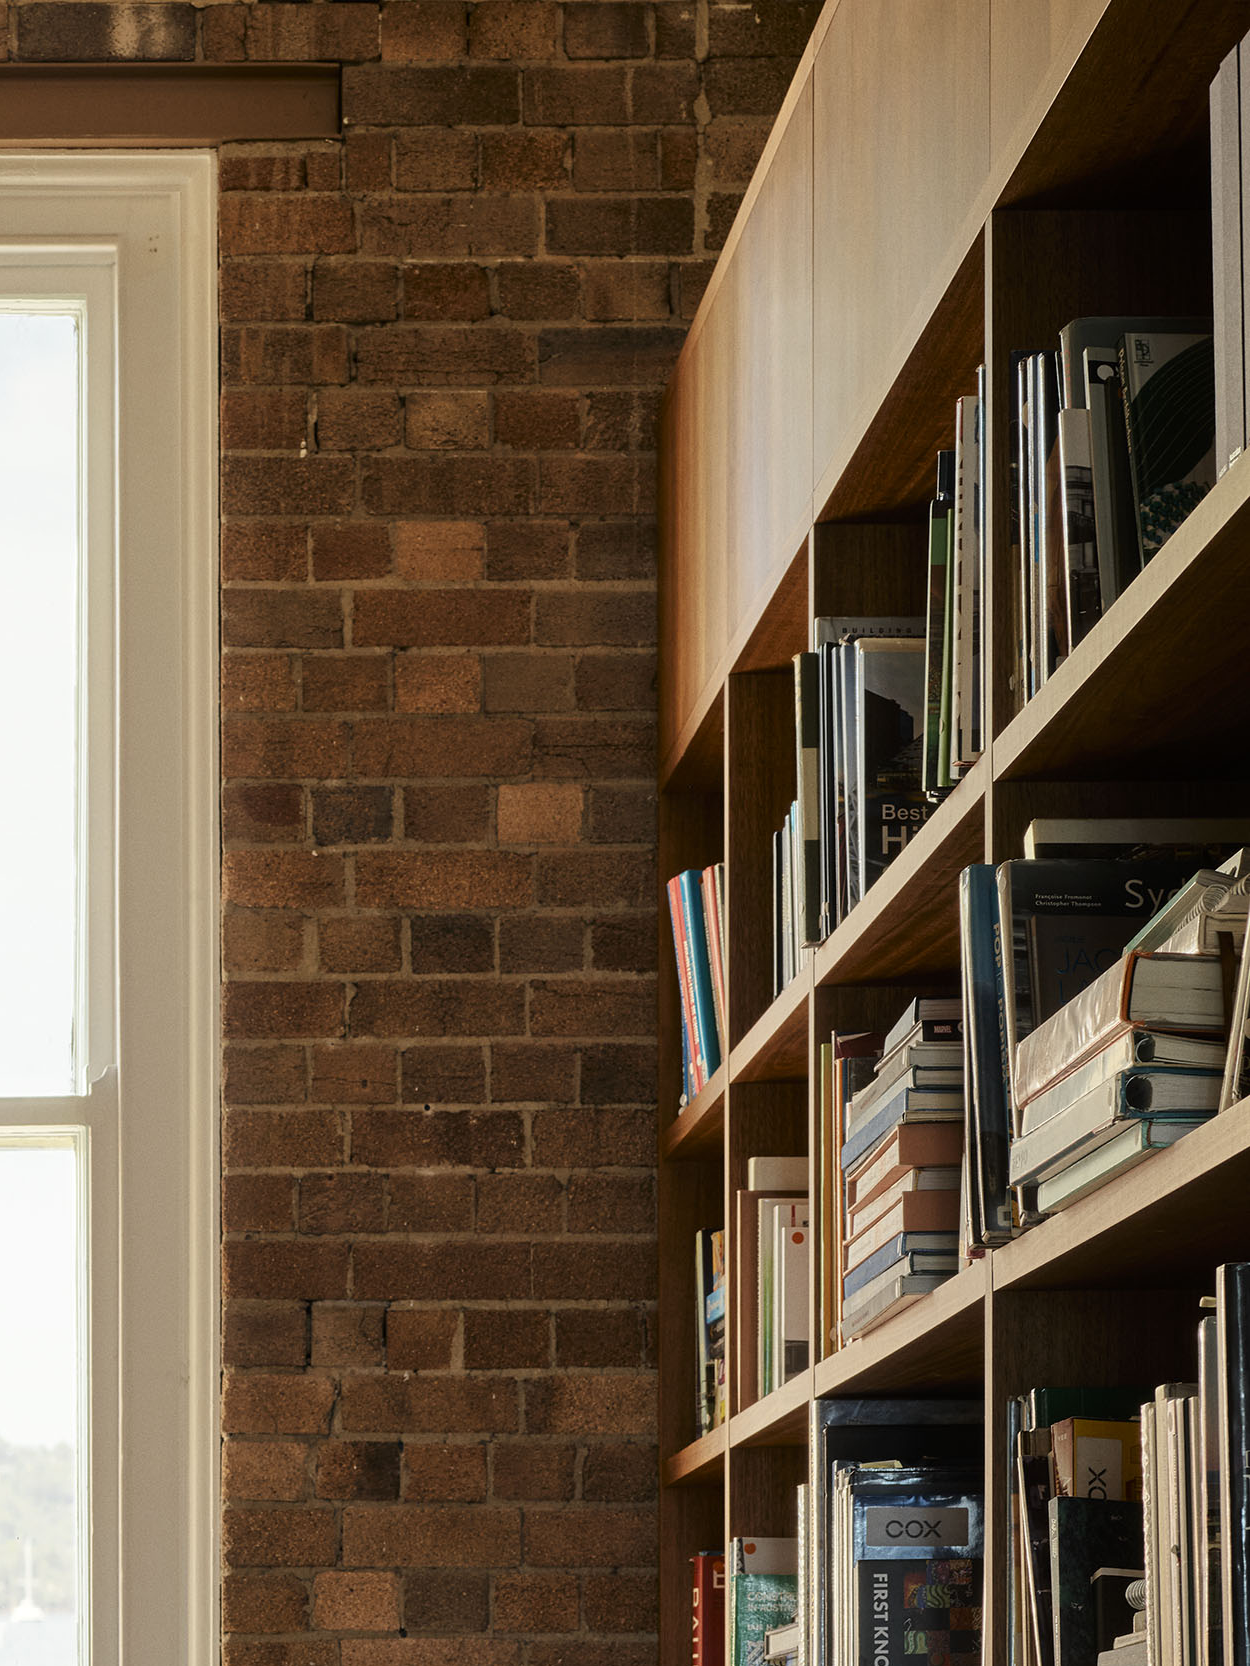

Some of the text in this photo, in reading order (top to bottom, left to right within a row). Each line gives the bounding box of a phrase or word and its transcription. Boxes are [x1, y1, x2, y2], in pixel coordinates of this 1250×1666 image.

[842, 626, 913, 635] BUILDING
[882, 803, 928, 820] Best
[993, 923, 1002, 967] POP
[1088, 1467, 1108, 1501] OX
[885, 1520, 942, 1538] COX
[873, 1573, 888, 1622] FIRST
